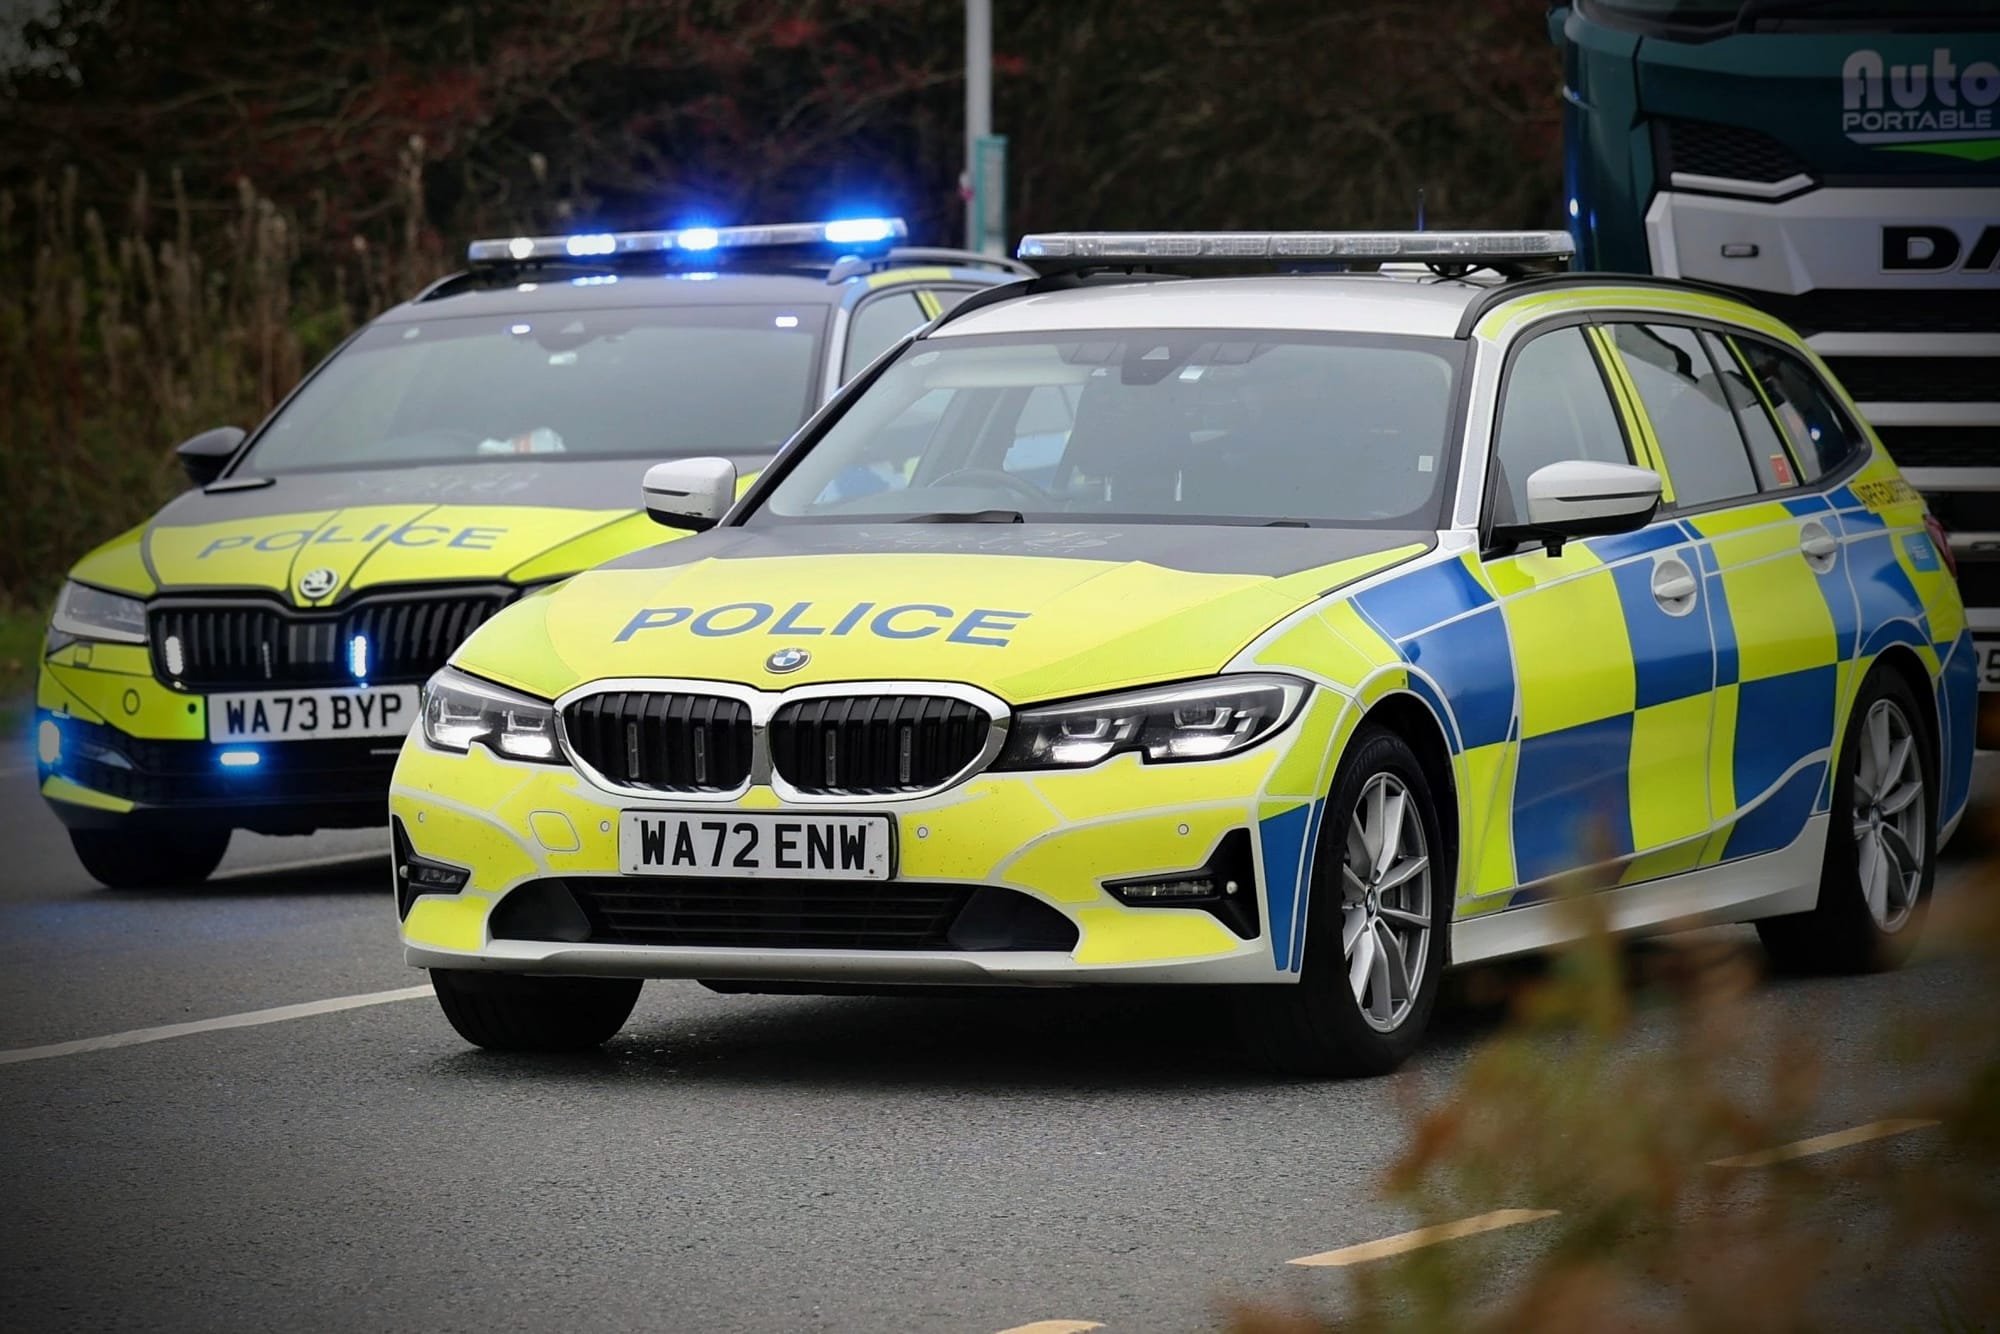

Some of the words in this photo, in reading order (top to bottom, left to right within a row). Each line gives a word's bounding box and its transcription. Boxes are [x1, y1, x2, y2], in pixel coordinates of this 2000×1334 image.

[1842, 48, 2000, 109] Auto
[1842, 109, 1993, 131] PORTABLE
[197, 524, 508, 559] POLICE
[612, 602, 1032, 647] POLICE
[226, 695, 319, 735] WA73
[331, 693, 401, 730] BYP
[640, 820, 760, 868] WA72
[774, 823, 867, 871] ENW
